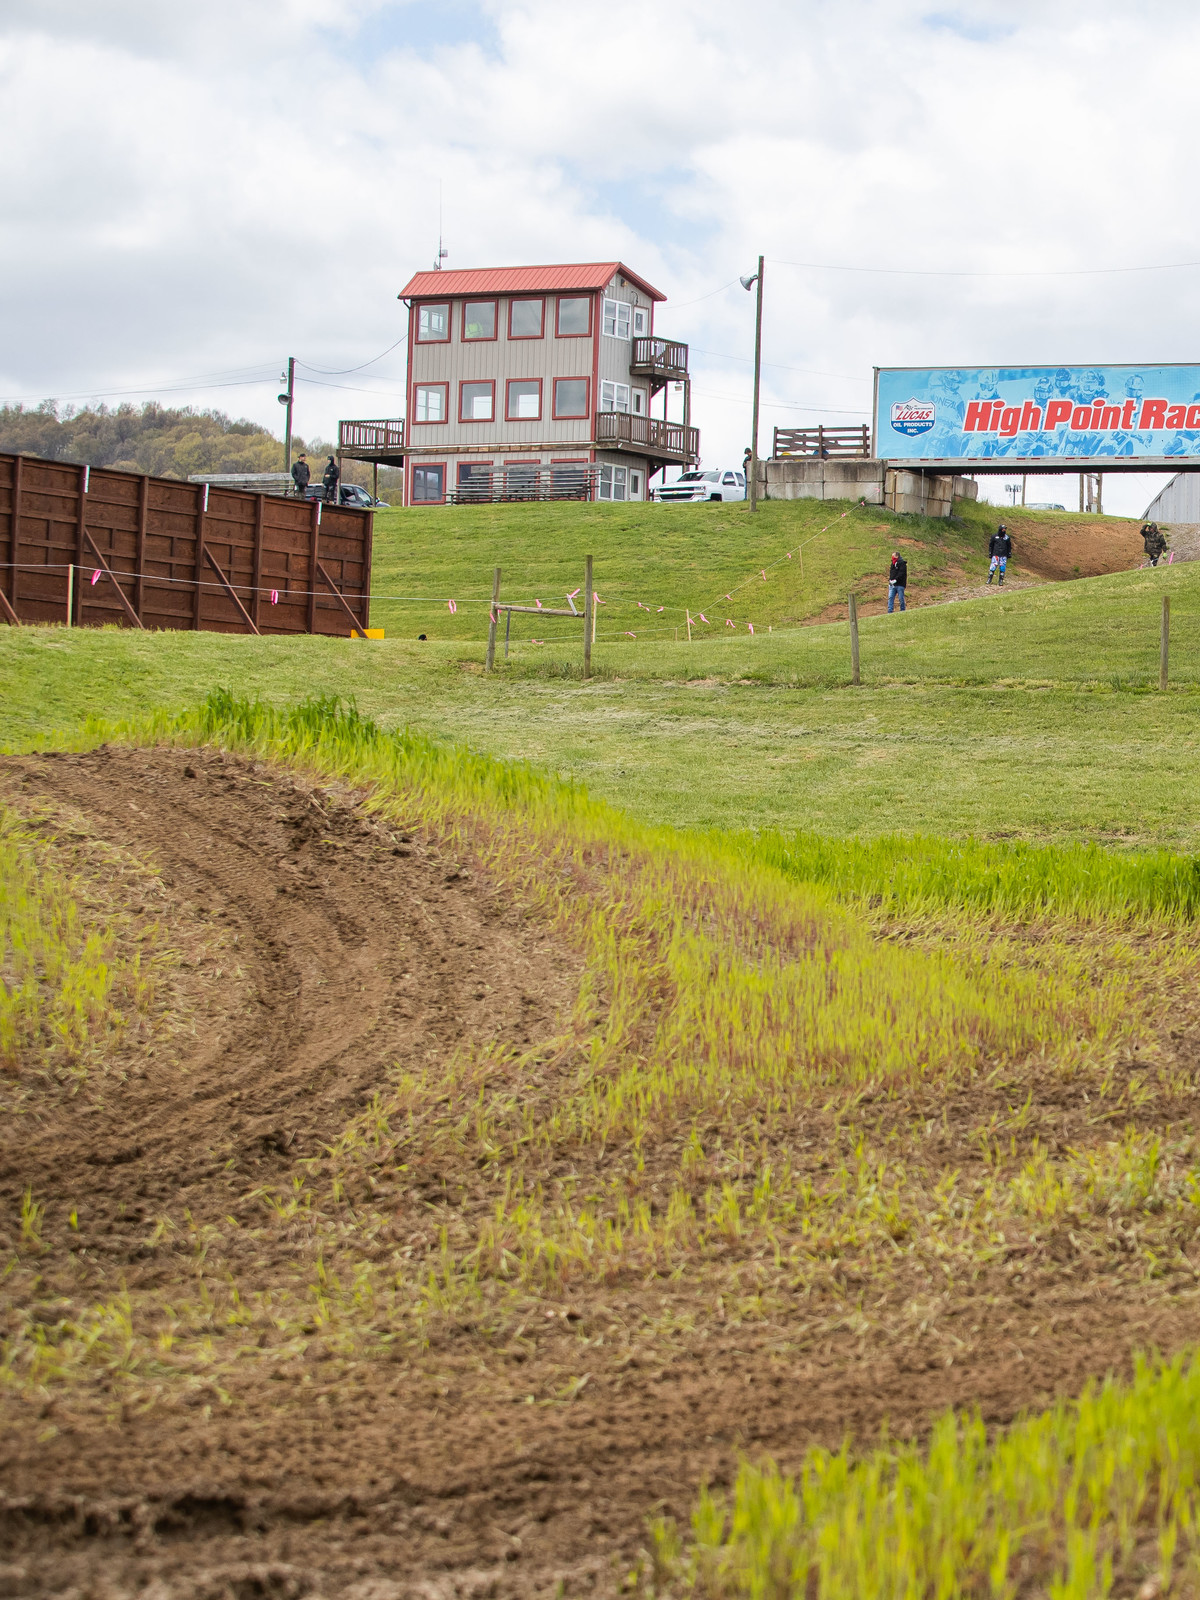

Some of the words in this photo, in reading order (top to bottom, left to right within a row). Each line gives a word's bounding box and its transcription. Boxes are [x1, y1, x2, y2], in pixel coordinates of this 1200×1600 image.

[895, 411, 932, 420] LUCAS
[963, 400, 1042, 437] High
[1043, 400, 1137, 431] Point
